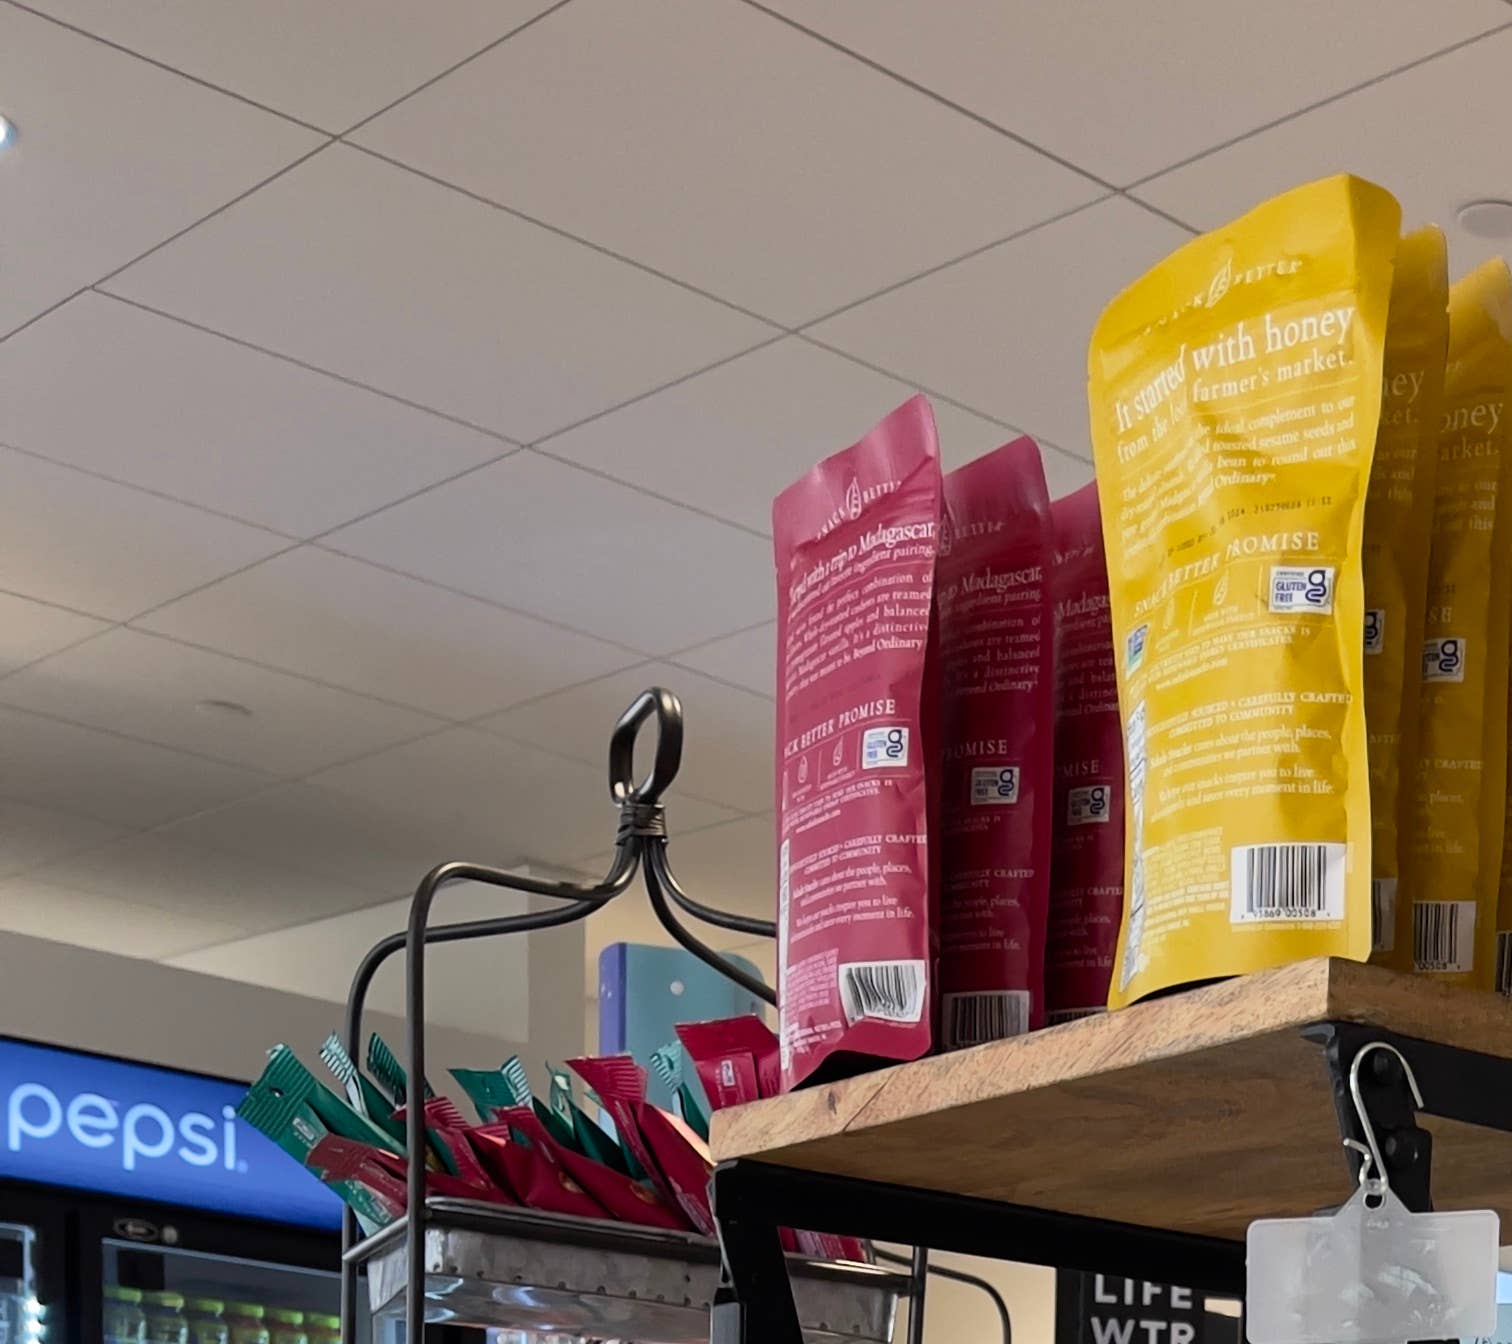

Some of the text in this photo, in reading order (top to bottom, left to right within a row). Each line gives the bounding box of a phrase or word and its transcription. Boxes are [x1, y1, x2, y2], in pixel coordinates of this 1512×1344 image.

[1115, 304, 1355, 433] It started with honey
[1192, 348, 1353, 403] farmer's market.
[1275, 580, 1307, 592] GLUTEN
[838, 699, 896, 728] PROMISE
[8, 1082, 236, 1171] pepsi
[1095, 1273, 1193, 1309] LIFE
